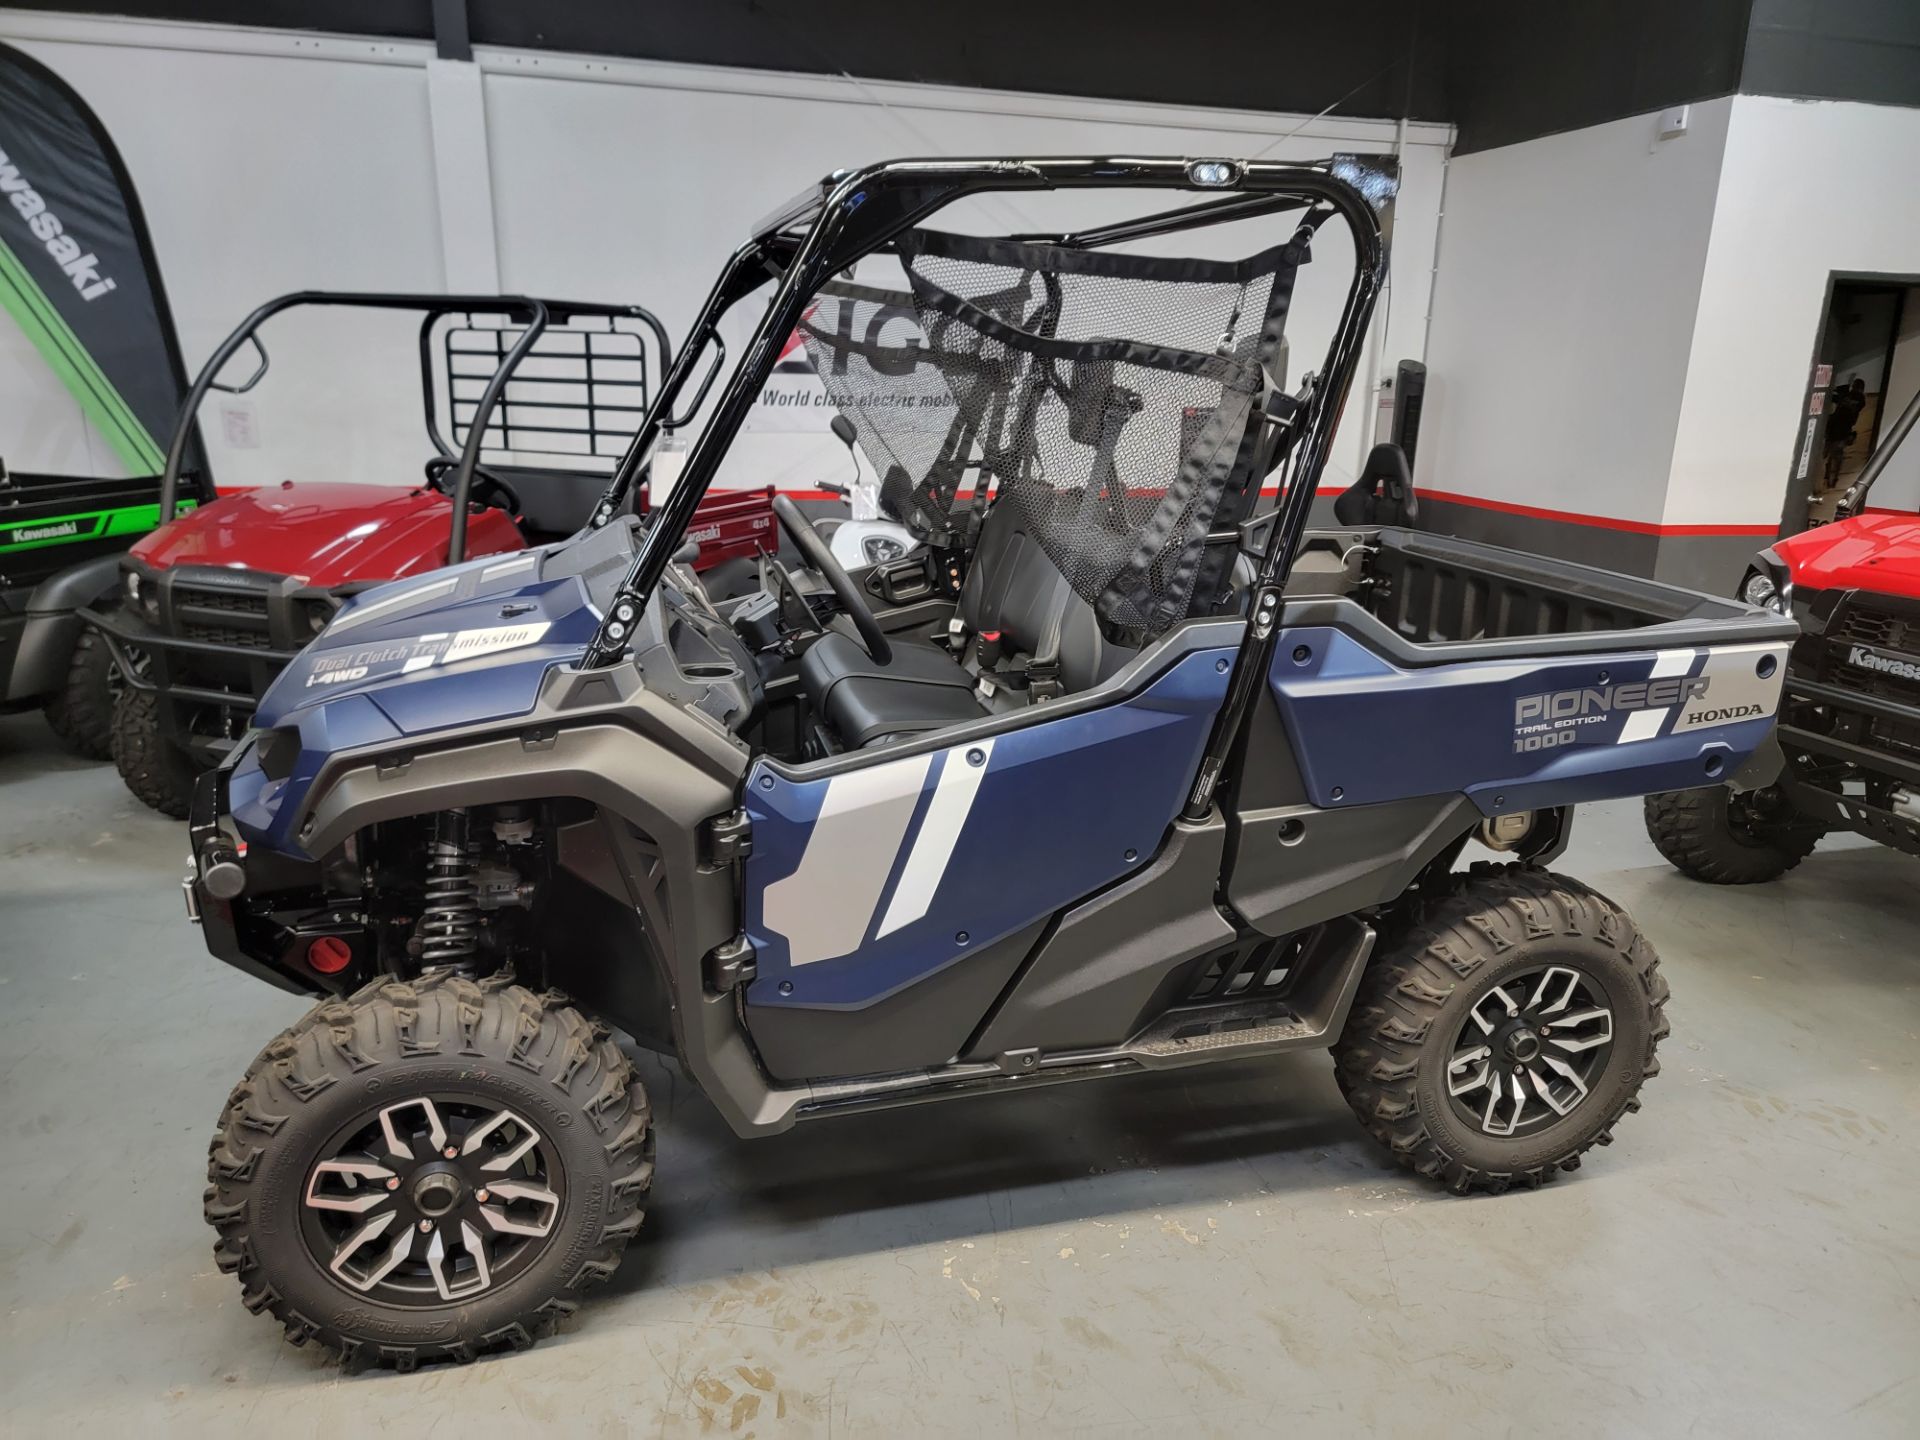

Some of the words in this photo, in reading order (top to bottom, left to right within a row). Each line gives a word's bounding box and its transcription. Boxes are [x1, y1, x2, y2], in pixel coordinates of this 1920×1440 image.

[762, 389, 810, 407] World
[814, 389, 854, 408] class
[12, 521, 78, 543] Kawasaki
[314, 654, 351, 673] Dual
[355, 644, 410, 666] Clutch
[1514, 675, 1712, 726] PIONEER
[1515, 723, 1554, 735] TRAIL
[1554, 714, 1608, 728] EDITION
[1687, 703, 1764, 726] HONDA
[1513, 729, 1577, 754] 1000
